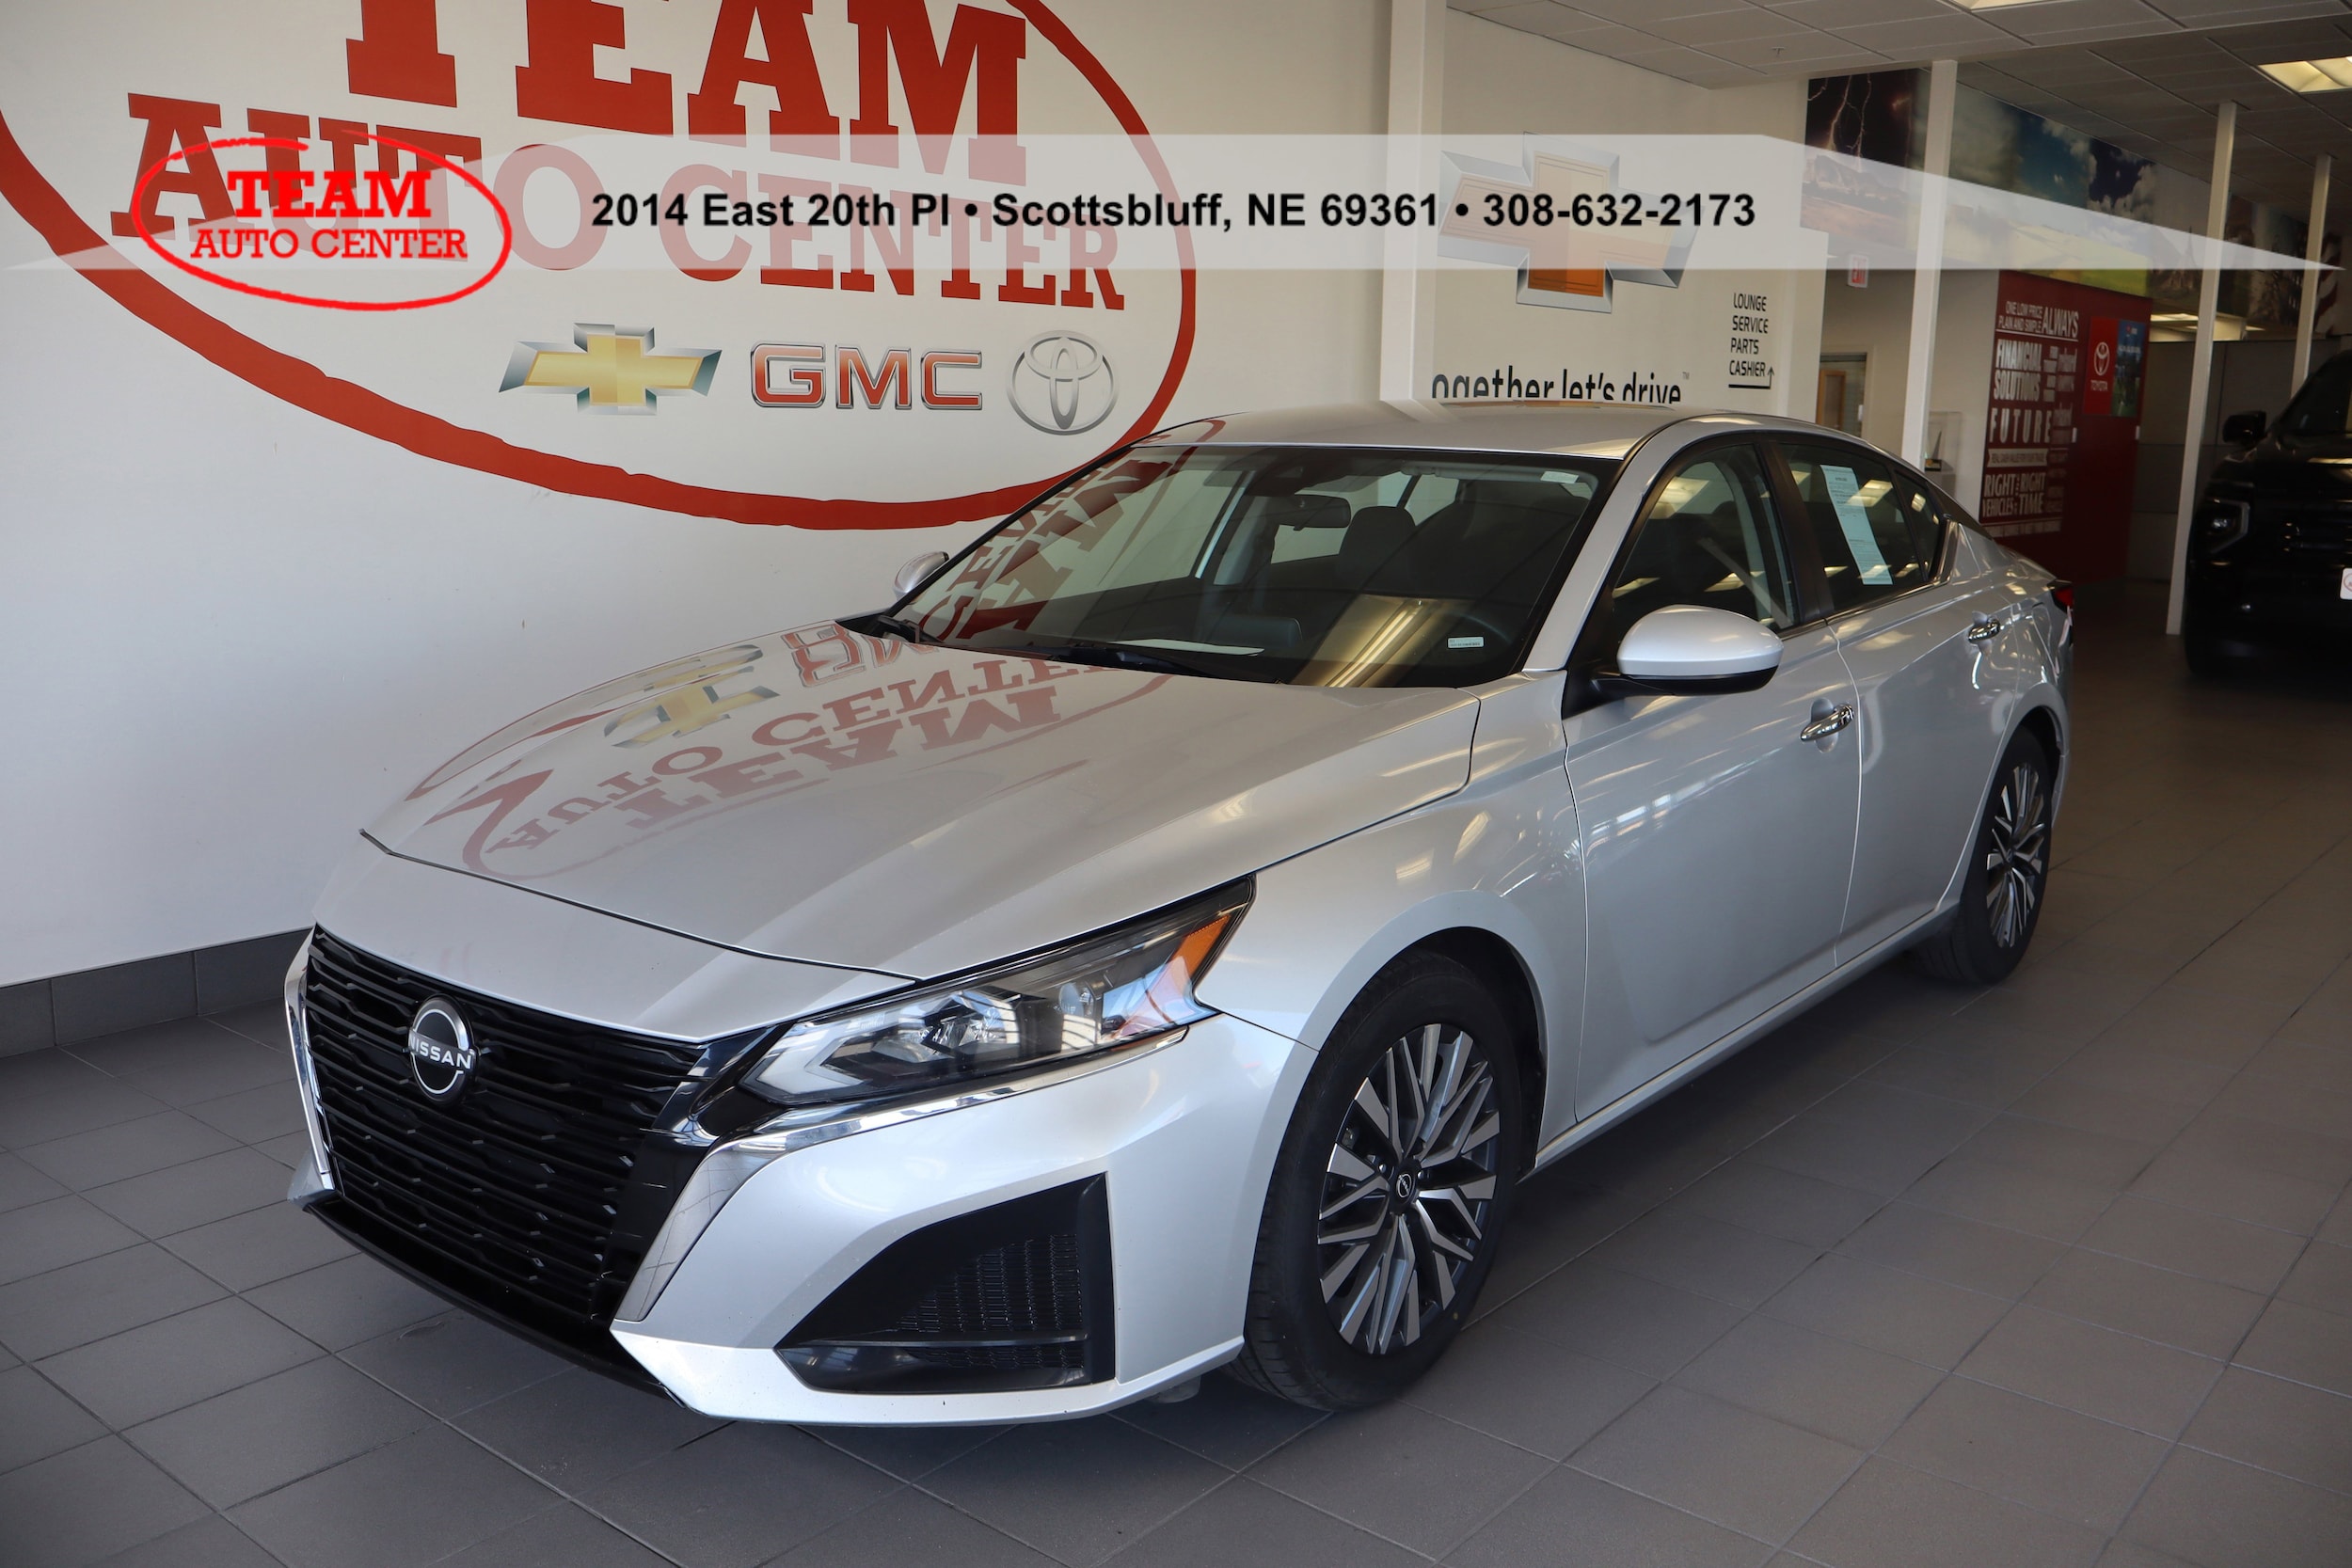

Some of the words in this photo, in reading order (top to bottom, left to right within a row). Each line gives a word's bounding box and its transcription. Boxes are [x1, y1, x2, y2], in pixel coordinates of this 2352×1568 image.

[110, 93, 609, 271] AUTO
[659, 164, 1125, 310] CENTER
[1734, 292, 1767, 311] LOUNGE
[1732, 315, 1769, 334] SERVICE
[2042, 307, 2079, 339] ALWAYS
[1730, 337, 1759, 355] PARTS
[1995, 339, 2042, 372] FINANCIAL
[750, 341, 983, 410] GMC
[1431, 365, 1554, 399] ogether
[1729, 359, 1766, 377] CASHIER
[1994, 370, 2041, 402] SOLUTIONS
[1989, 407, 2053, 443] FUTURE
[1984, 473, 2016, 498] RIGHT
[2020, 471, 2046, 492] RIGHT
[2019, 493, 2044, 515] TIME
[409, 1035, 471, 1069] NISSAN
